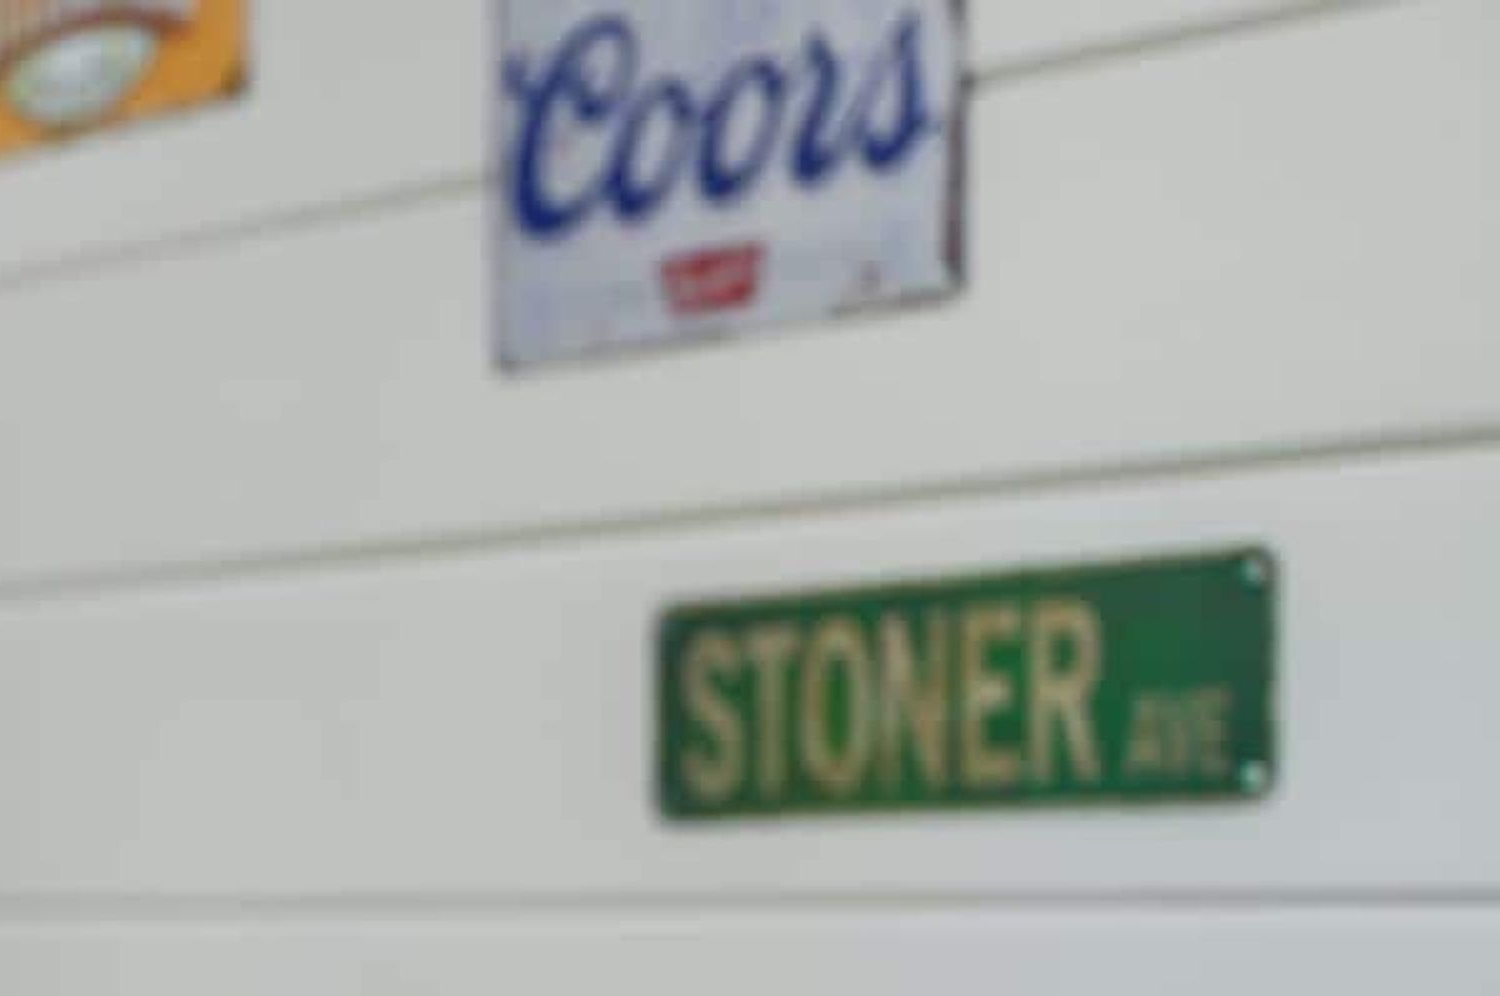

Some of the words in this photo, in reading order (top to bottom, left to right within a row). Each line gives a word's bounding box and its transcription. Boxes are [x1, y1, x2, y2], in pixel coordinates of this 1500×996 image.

[503, 12, 934, 240] Coors
[678, 599, 1102, 798] STONER
[1124, 688, 1232, 777] AVE
